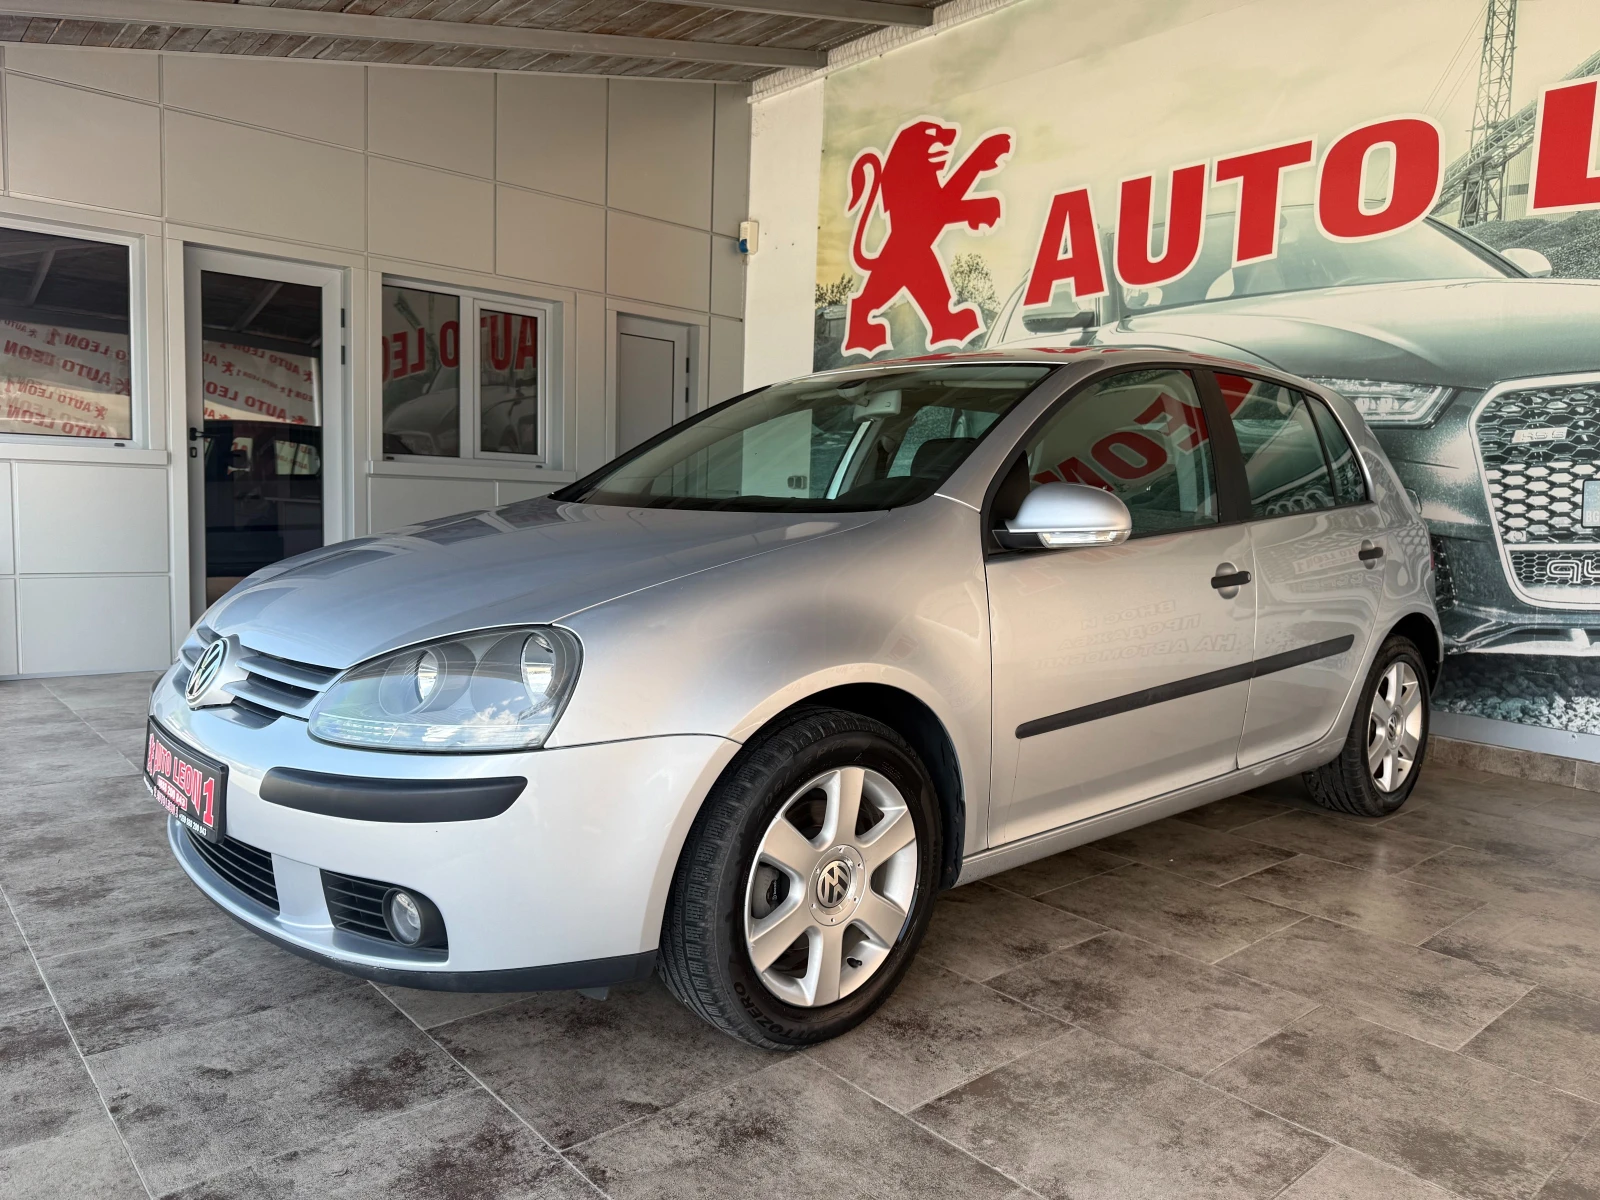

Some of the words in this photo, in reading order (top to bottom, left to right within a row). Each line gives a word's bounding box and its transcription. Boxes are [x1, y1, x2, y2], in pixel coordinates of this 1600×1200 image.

[1022, 115, 1442, 307] AUTO
[152, 740, 172, 778] AUTO
[172, 756, 202, 816] LEON
[202, 777, 215, 828] 1
